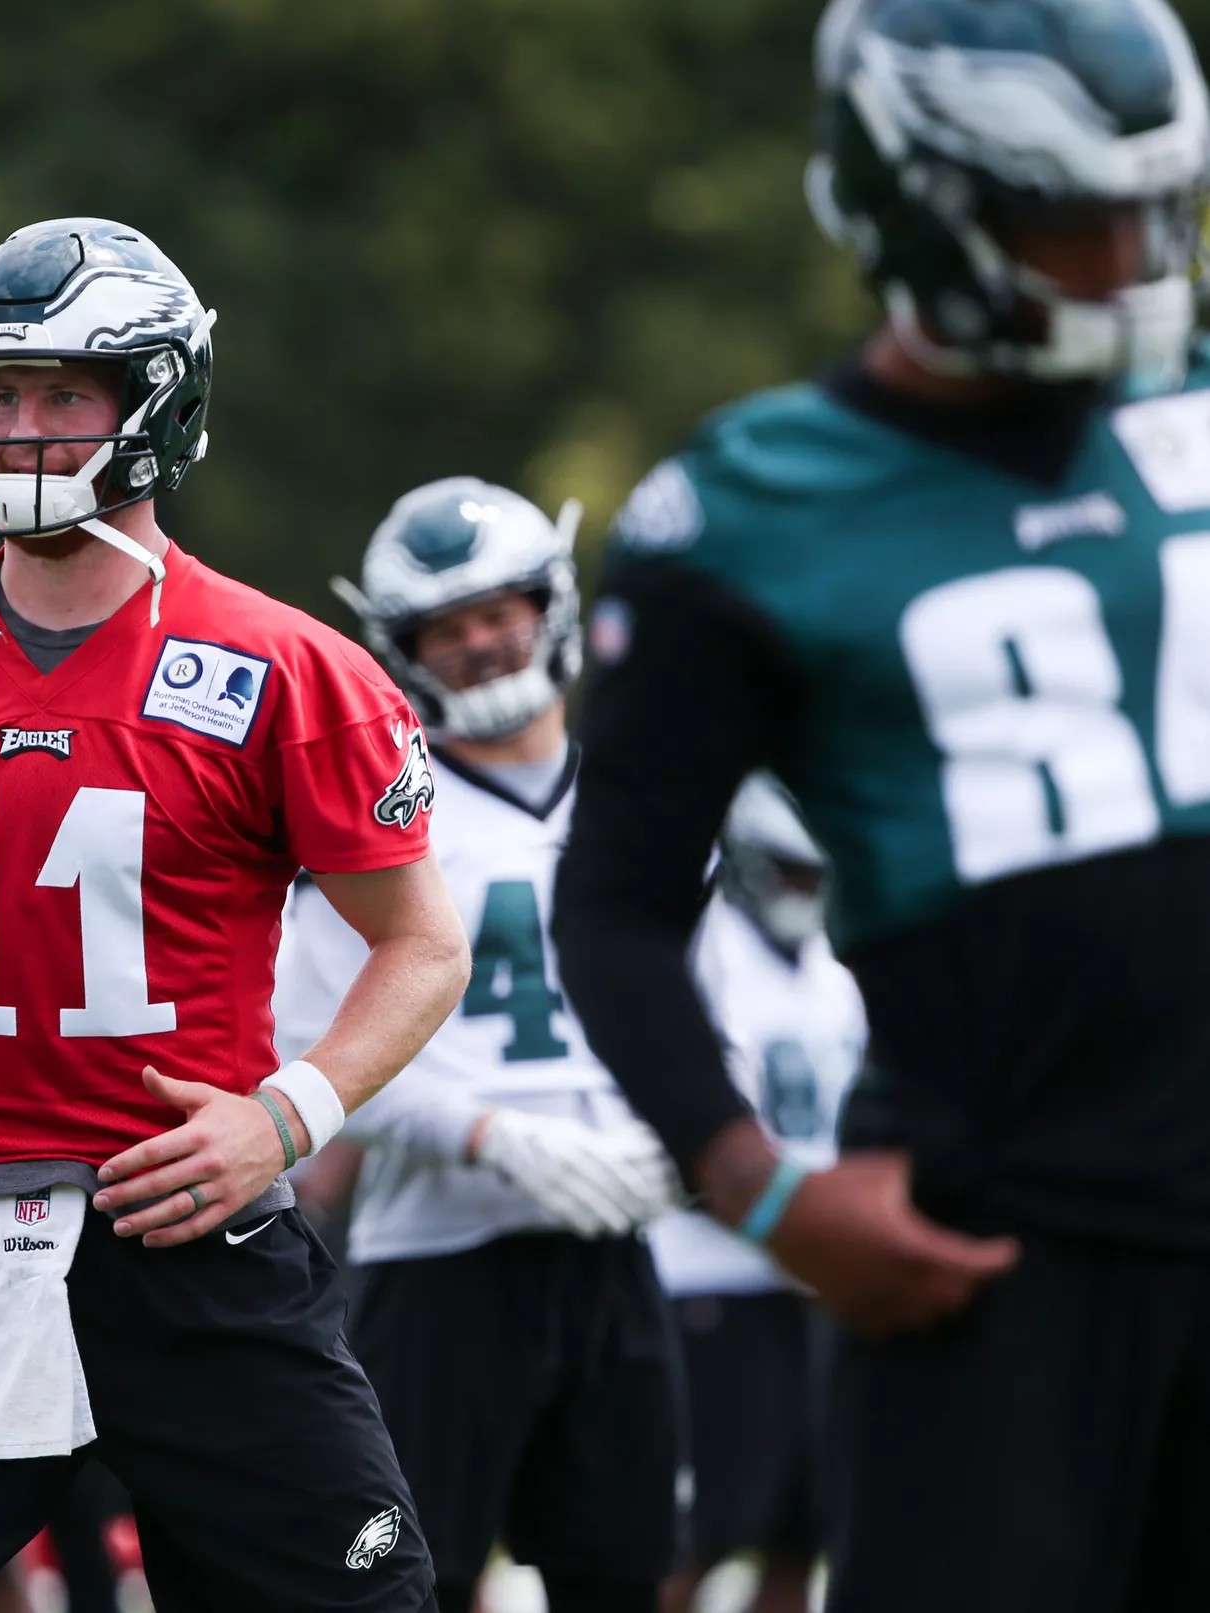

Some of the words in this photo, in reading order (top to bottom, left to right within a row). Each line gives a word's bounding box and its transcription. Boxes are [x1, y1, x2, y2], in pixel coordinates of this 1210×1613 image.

[174, 663, 188, 677] R
[153, 690, 191, 706] Rothman
[191, 699, 246, 726] Orthopaedics
[158, 700, 169, 710] at
[168, 702, 206, 722] Jefferson
[206, 716, 234, 731] Health
[462, 880, 570, 1061] 4
[17, 1201, 47, 1223] NFL
[3, 1236, 60, 1253] Wilson
